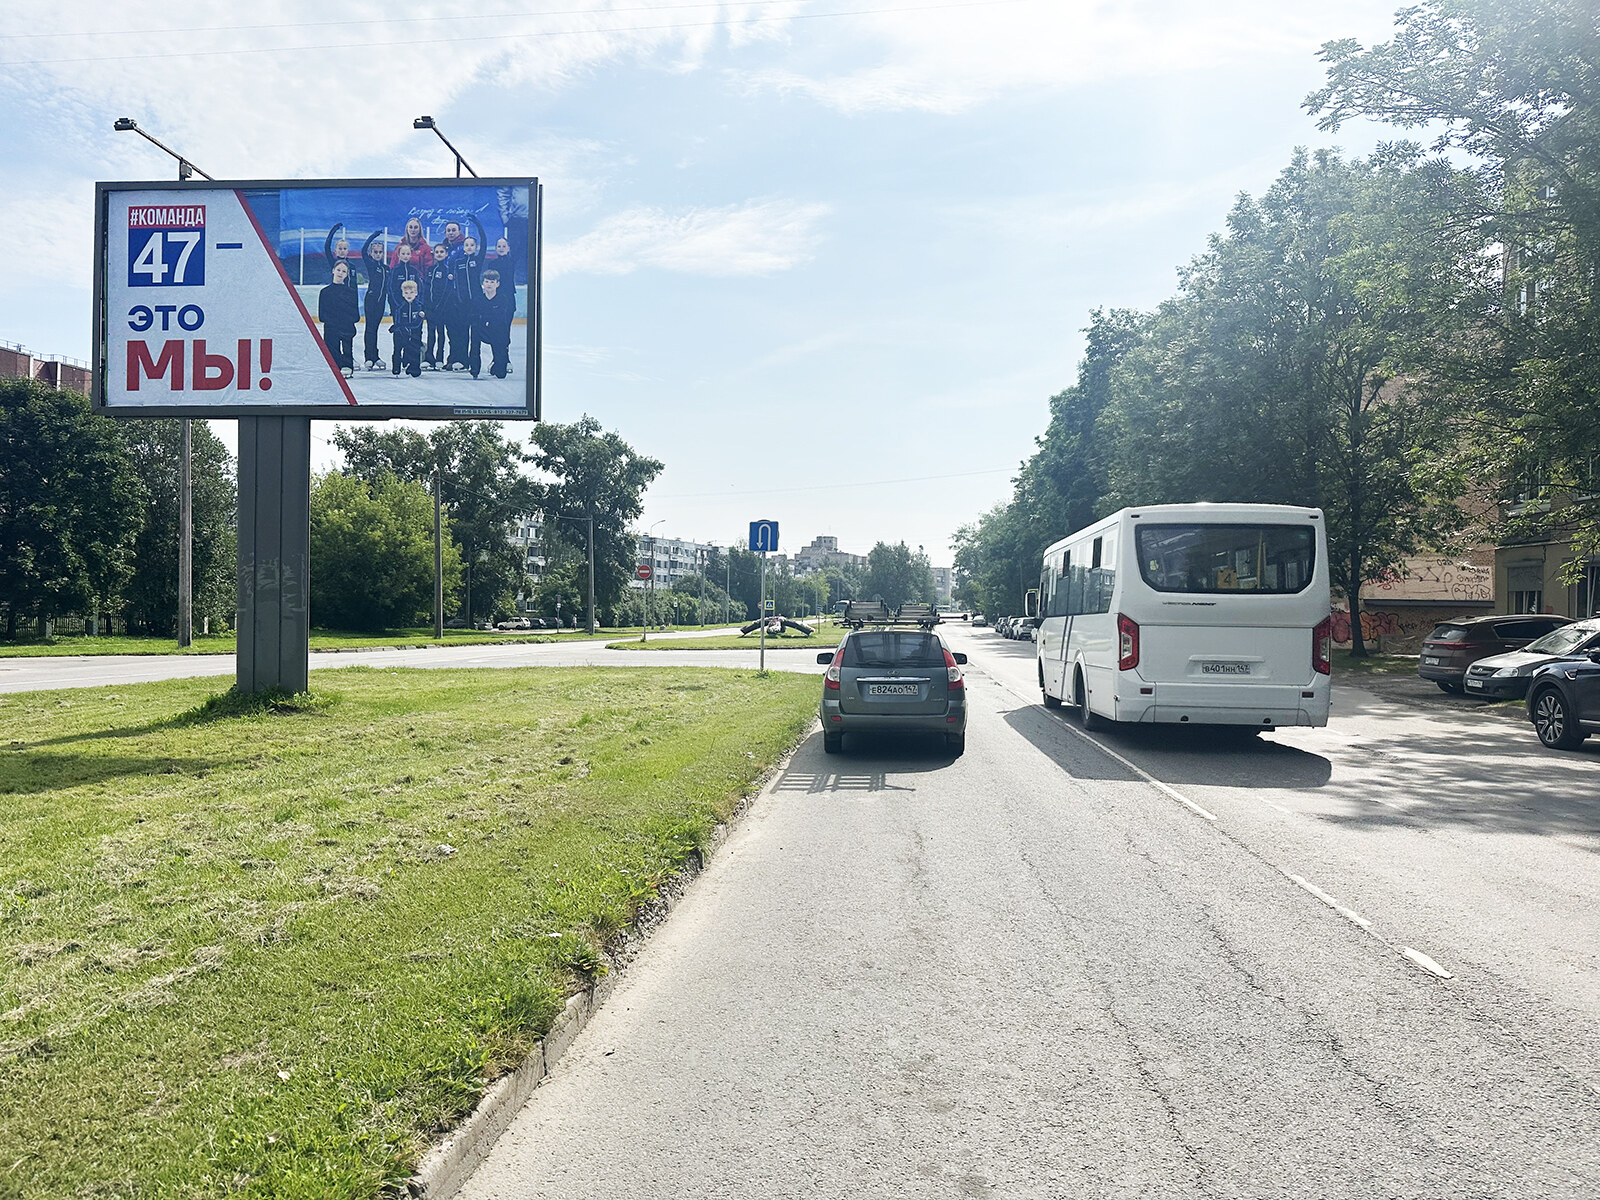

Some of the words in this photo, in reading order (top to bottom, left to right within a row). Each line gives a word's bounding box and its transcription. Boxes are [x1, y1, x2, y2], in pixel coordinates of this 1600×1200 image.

[130, 208, 204, 227] #КОМАНДА
[133, 231, 201, 283] 47
[127, 304, 205, 332] ЭТО
[126, 338, 273, 391] МЫ!
